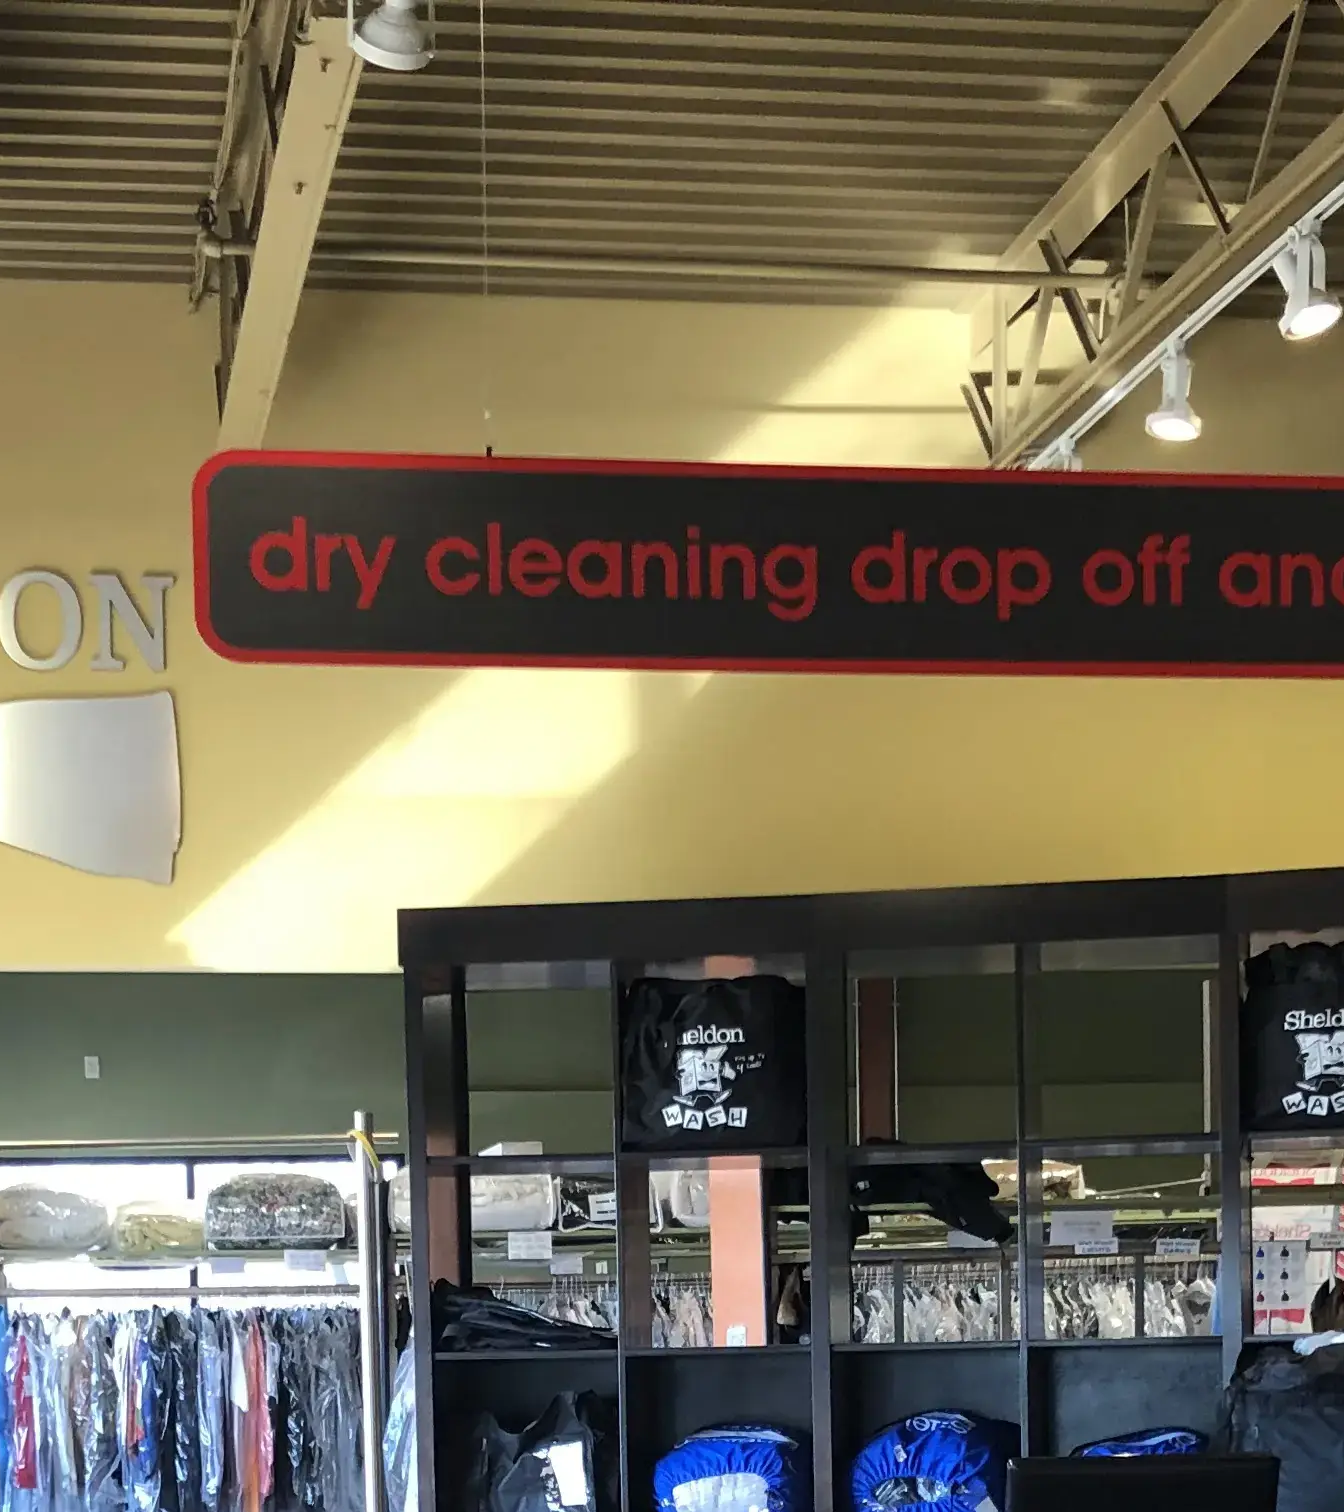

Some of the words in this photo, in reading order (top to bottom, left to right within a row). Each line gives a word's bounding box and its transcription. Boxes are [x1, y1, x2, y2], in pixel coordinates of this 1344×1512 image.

[249, 515, 396, 610] dry
[425, 521, 818, 622] cleaning
[850, 529, 1053, 622] drop
[1082, 533, 1191, 607] off
[663, 1104, 747, 1128] WASH
